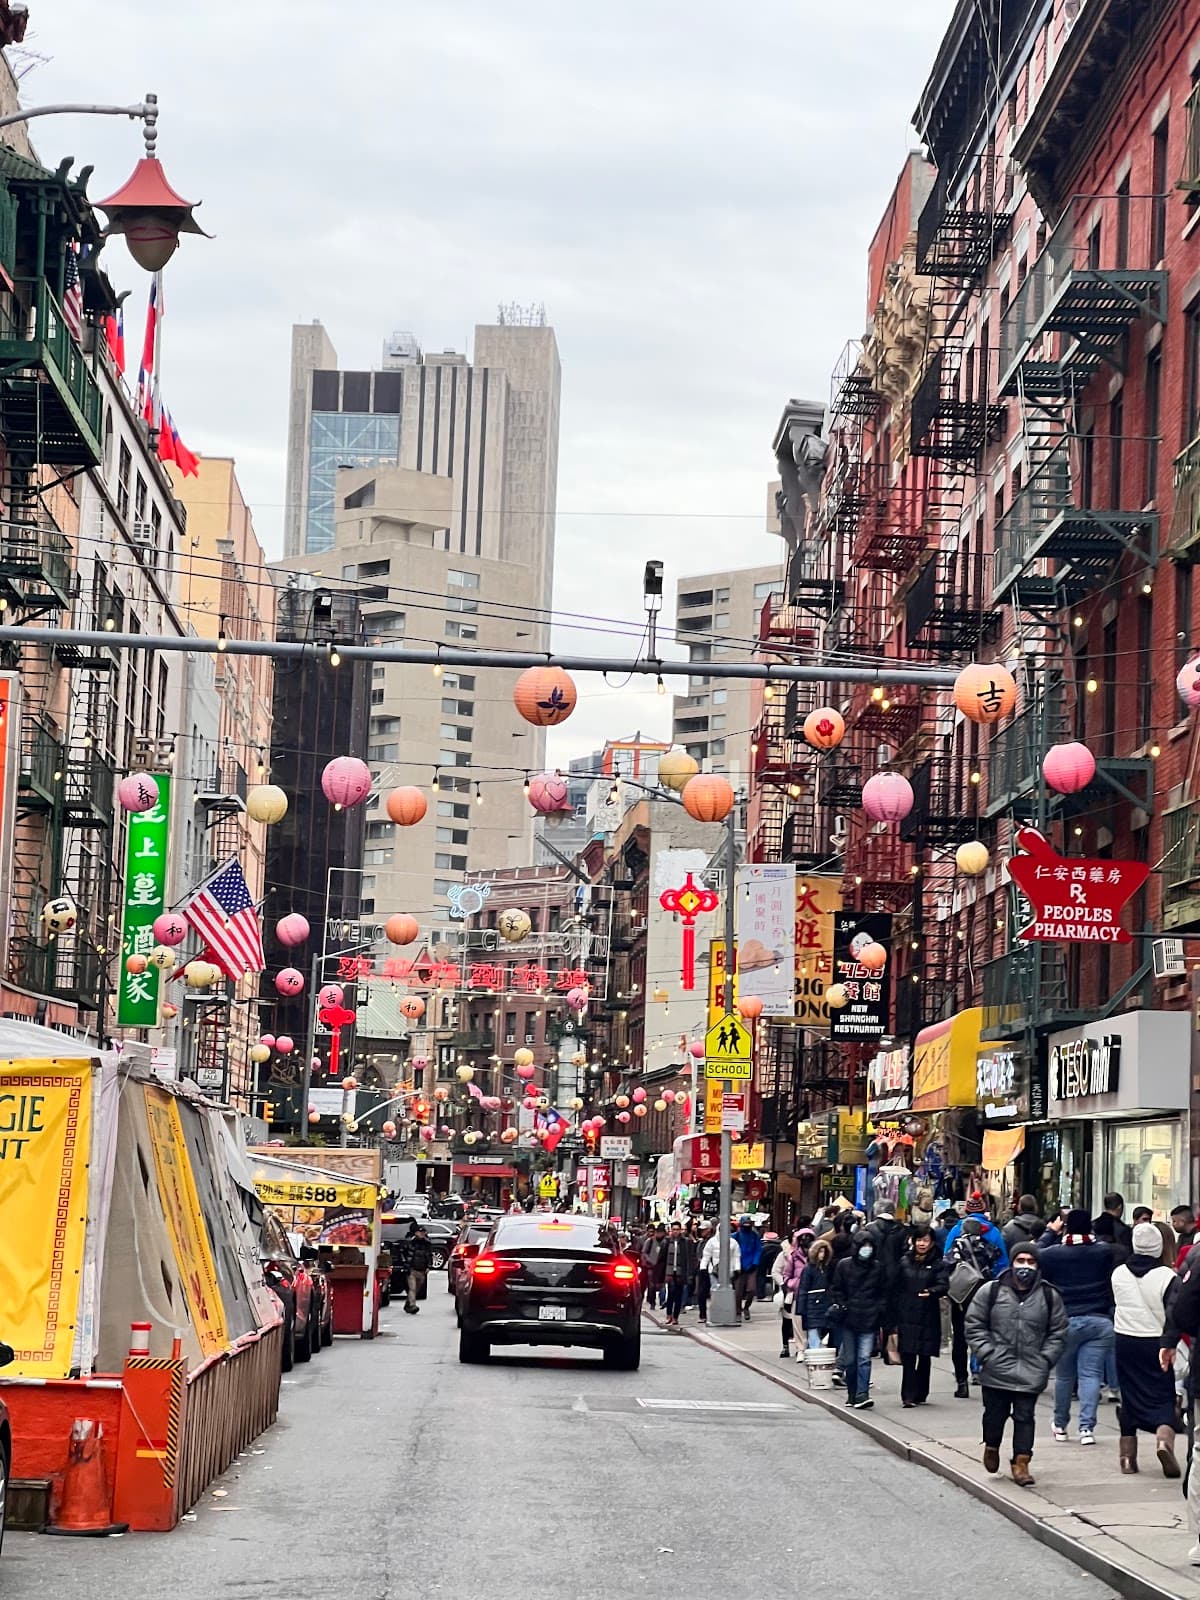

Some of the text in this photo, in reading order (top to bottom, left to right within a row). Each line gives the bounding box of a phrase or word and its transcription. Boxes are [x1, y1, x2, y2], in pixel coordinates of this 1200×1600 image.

[976, 680, 1006, 714] 吉
[1034, 865, 1122, 885] 仁安西藥房
[1043, 905, 1113, 923] PEOPLES
[1033, 922, 1121, 940] PHARMACY
[794, 978, 824, 996] BIG
[851, 1004, 868, 1013] NEW
[839, 1014, 879, 1024] SHANGHAI
[834, 1024, 886, 1034] RESTAURANT
[708, 1064, 749, 1075] SCHOOL
[304, 1186, 337, 1203] $88
